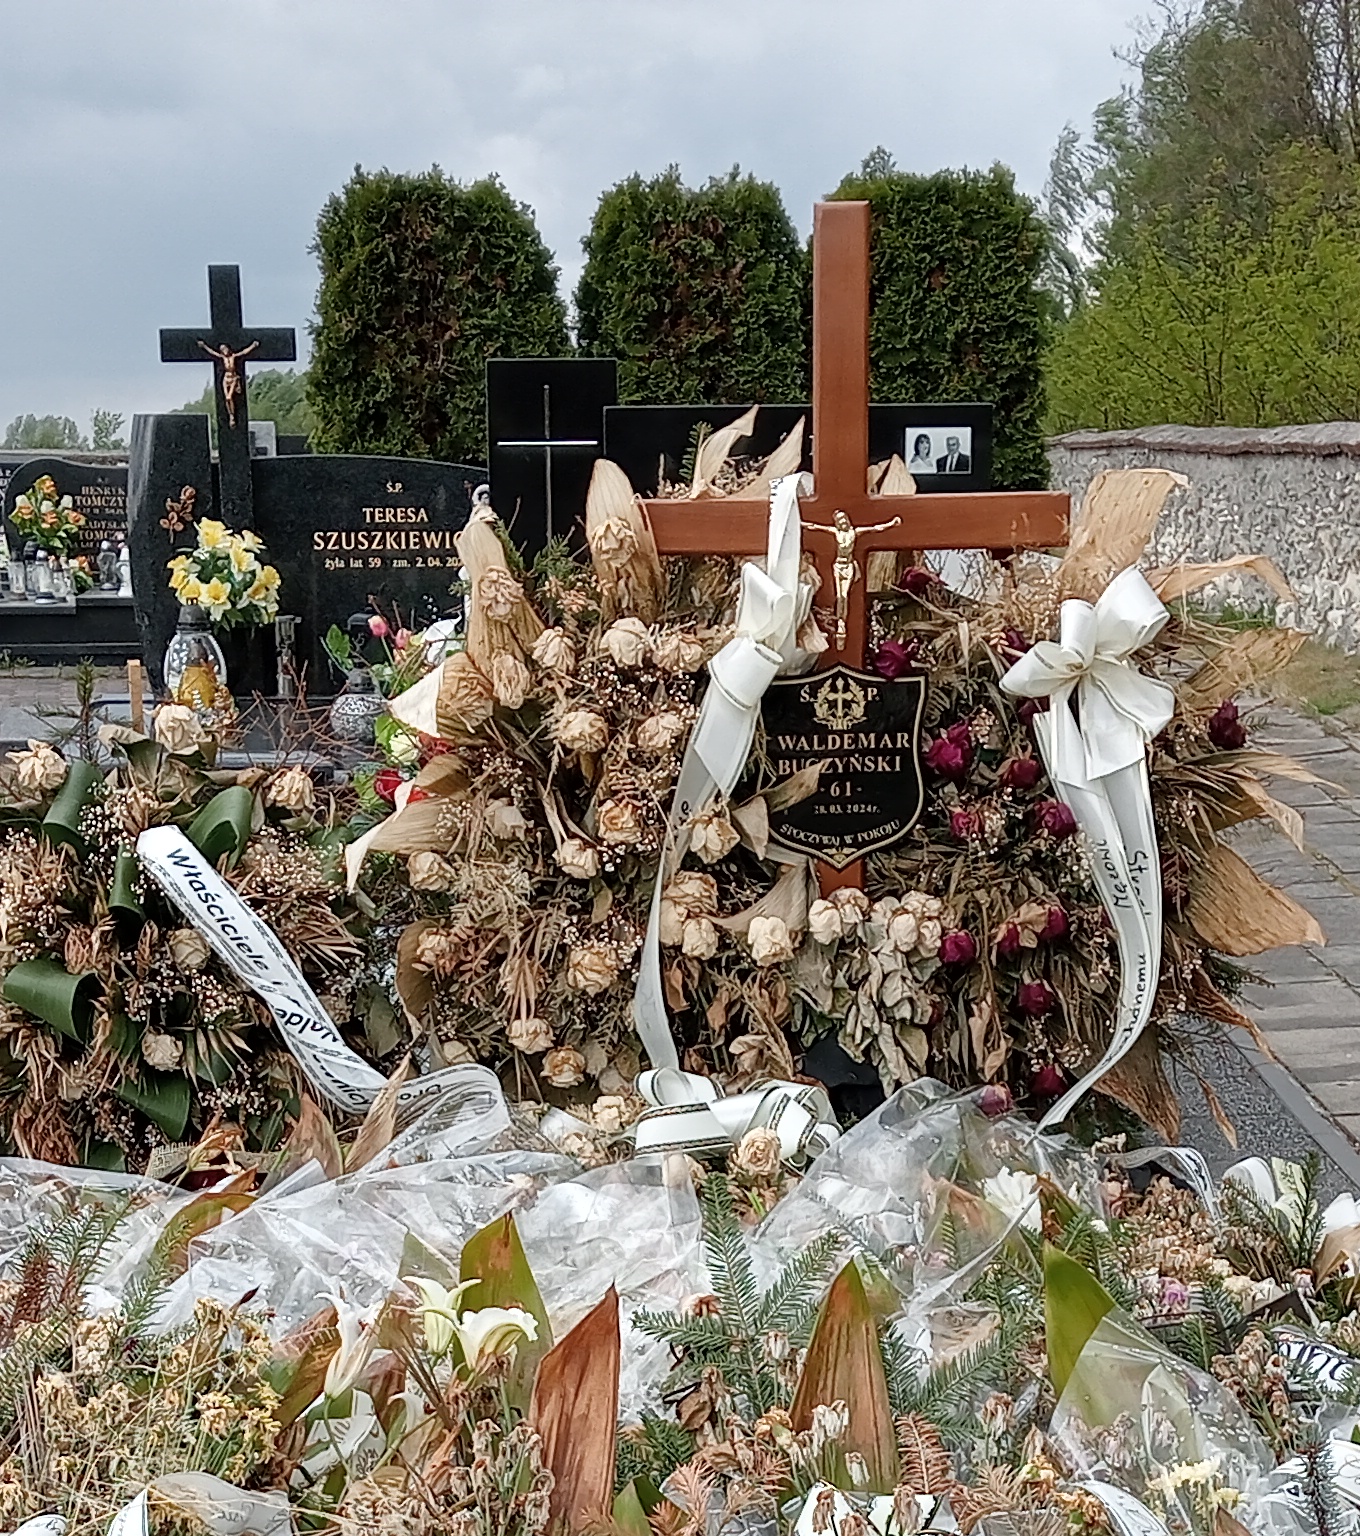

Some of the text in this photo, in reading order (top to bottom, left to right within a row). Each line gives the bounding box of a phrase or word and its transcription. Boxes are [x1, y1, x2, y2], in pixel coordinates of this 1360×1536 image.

[74, 496, 128, 507] TOMCZY
[362, 507, 429, 523] TERESA
[350, 558, 363, 568] lat
[368, 557, 382, 568] 59
[777, 732, 910, 750] WALDEMAR
[844, 834, 855, 845] W
[858, 819, 900, 842] POKOJU
[166, 848, 270, 972] Właściciele
